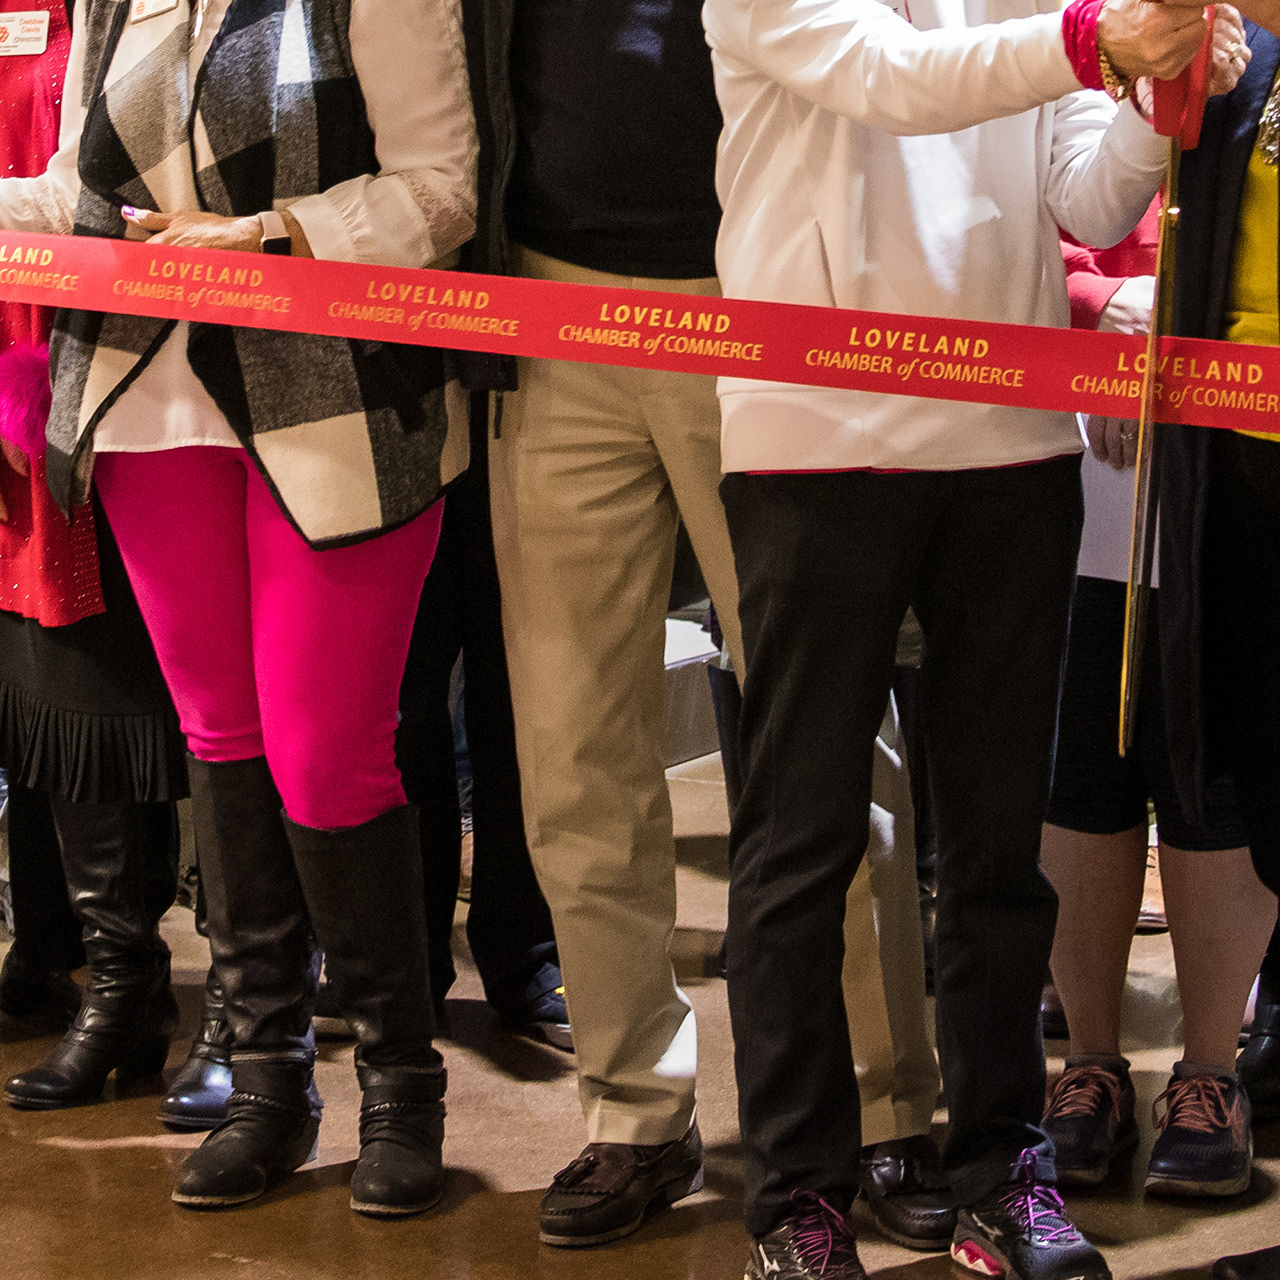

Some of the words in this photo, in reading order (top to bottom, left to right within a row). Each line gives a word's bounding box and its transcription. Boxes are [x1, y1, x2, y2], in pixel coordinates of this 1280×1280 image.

[148, 259, 263, 287] LOVELAND
[113, 280, 184, 302] CHAMBER
[188, 287, 208, 308] of
[205, 289, 292, 313] COMMERCE
[366, 281, 490, 309] LOVELAND
[328, 302, 405, 324] CHAMBER
[407, 310, 429, 331] of
[427, 312, 520, 337] COMMERCE
[599, 303, 731, 333] LOVELAND
[558, 324, 641, 348] CHAMBER
[643, 333, 666, 356] of
[663, 335, 764, 361] COMMERCE
[849, 326, 989, 359] LOVELAND
[805, 348, 893, 374] CHAMBER
[896, 358, 920, 381] of
[919, 360, 1025, 388] COMMERCE
[1070, 374, 1164, 400] CHAMBR
[1169, 385, 1193, 408] of
